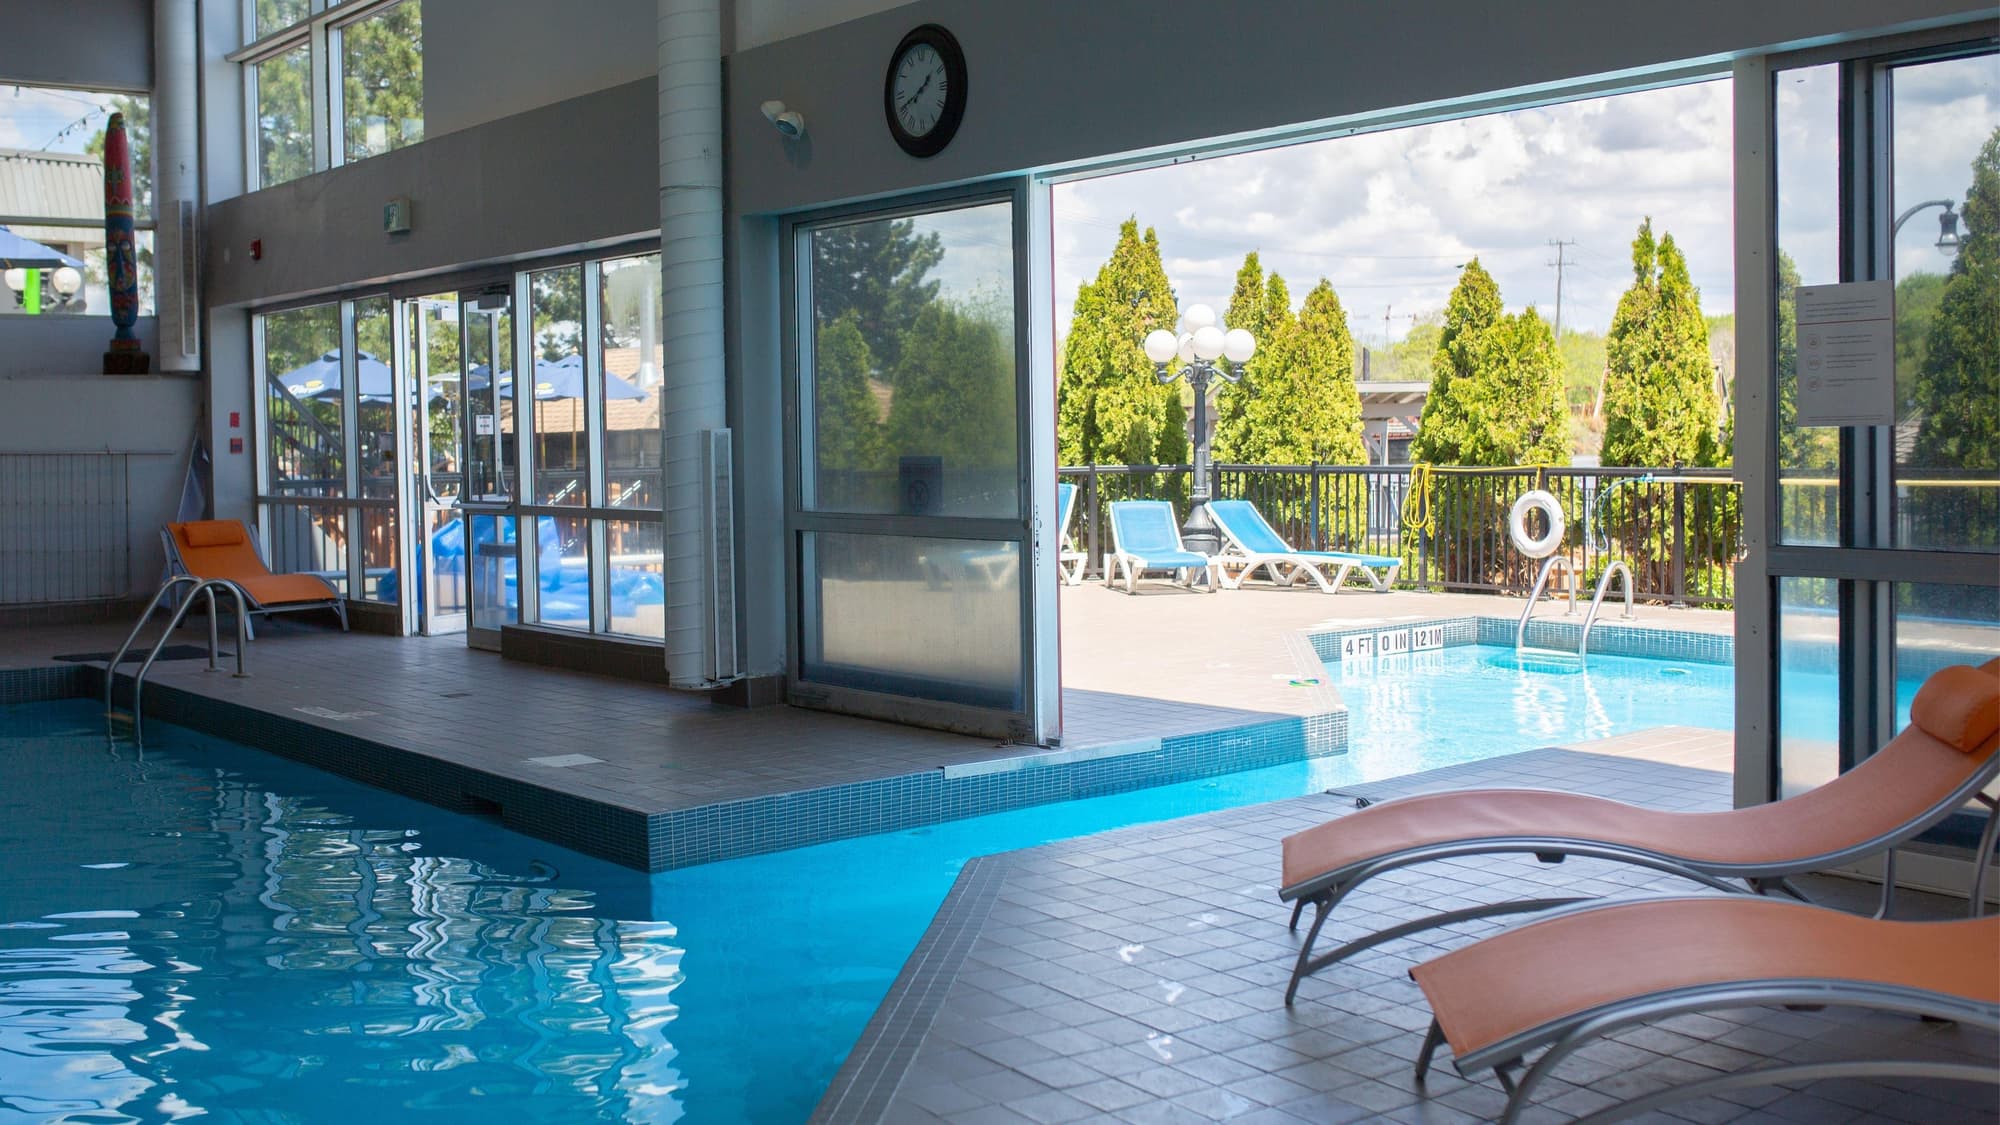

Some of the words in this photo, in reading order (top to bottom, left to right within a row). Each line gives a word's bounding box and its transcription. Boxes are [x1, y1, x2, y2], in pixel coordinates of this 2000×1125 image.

[1345, 639, 1354, 656] 4
[1358, 637, 1372, 655] FT
[1395, 632, 1407, 650] IN
